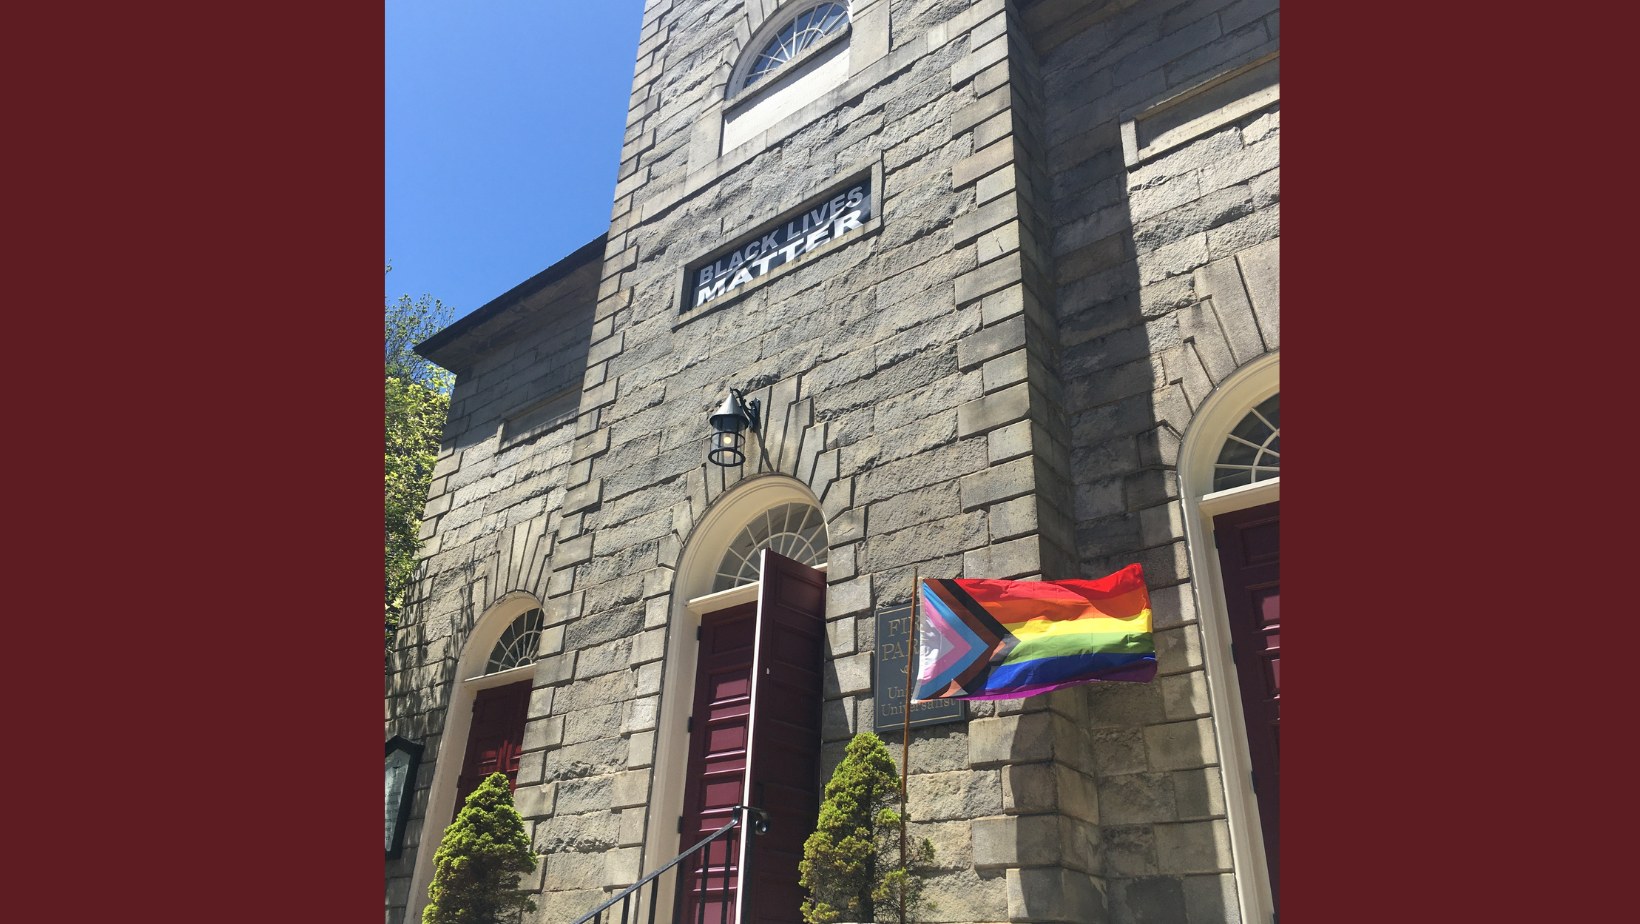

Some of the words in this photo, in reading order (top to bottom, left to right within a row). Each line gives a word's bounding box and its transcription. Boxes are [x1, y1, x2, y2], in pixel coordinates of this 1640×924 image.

[698, 229, 779, 287] BLACK
[786, 186, 864, 241] LIVES
[696, 209, 864, 307] MATTER
[888, 615, 920, 637] FIR
[882, 638, 920, 661] PAR
[881, 698, 956, 716] Uniersalist
